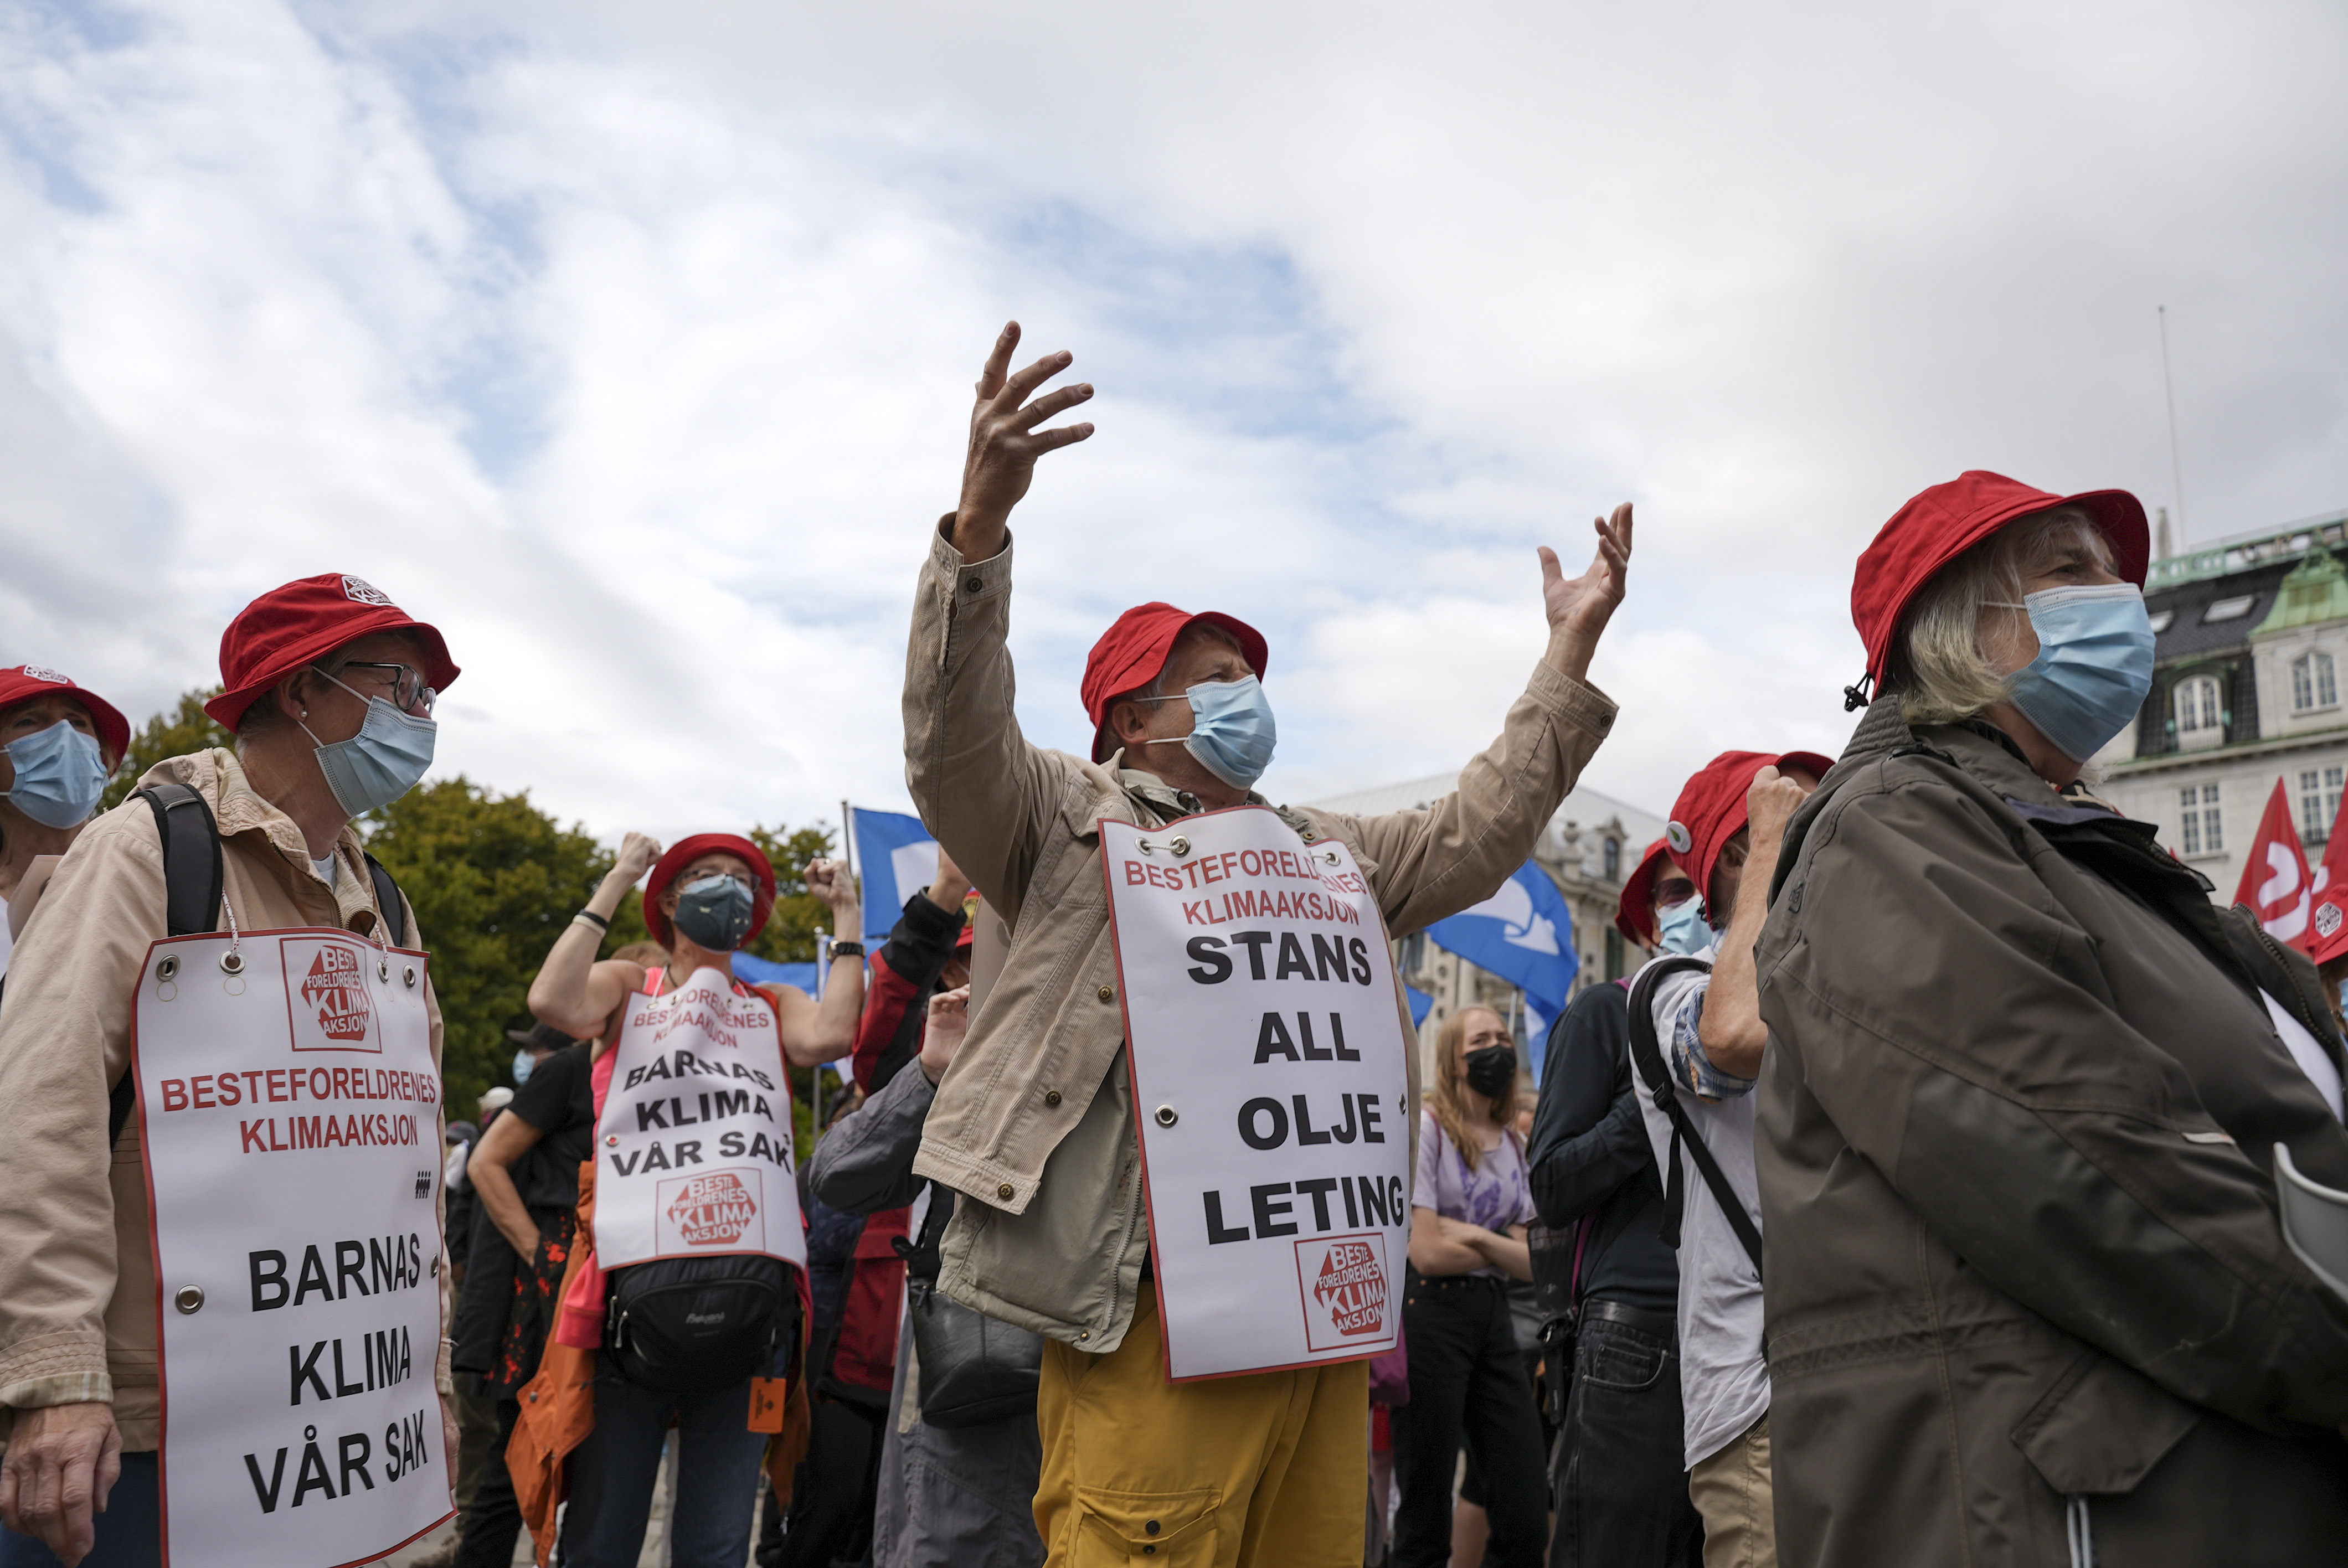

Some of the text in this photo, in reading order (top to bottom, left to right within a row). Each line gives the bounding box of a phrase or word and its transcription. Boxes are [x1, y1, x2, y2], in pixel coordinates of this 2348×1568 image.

[1182, 890, 1359, 925] KLIMAAKSJON
[320, 946, 354, 972] BESTE
[1187, 931, 1372, 986] STANS
[306, 971, 361, 989] FORELDRENES
[308, 989, 370, 1018] KLIMA
[323, 1014, 368, 1034] AKSJON
[1254, 1012, 1361, 1064] ALL
[624, 1050, 775, 1092] BARNAS
[161, 1067, 436, 1112] BESTEFORELDRENES
[636, 1090, 774, 1132] KLIMA
[1238, 1094, 1386, 1150] OLJE
[240, 1113, 419, 1153] KLIMAAKSJON
[610, 1131, 792, 1177] VÅR SAK
[672, 1187, 749, 1210] FORELDRENES
[689, 1176, 734, 1198] BESTE
[673, 1203, 753, 1230] KLIMA
[1203, 1175, 1404, 1245] LETING
[685, 1221, 746, 1241] AKSJON
[249, 1232, 421, 1312] BARNAS
[1319, 1259, 1380, 1290] FORELDRENES
[1329, 1245, 1369, 1272] BESTE
[1320, 1280, 1385, 1316] KLIMA
[1337, 1303, 1383, 1331] AKSJON
[289, 1324, 411, 1406] KLIMA
[244, 1409, 428, 1514] VÅR SAK
